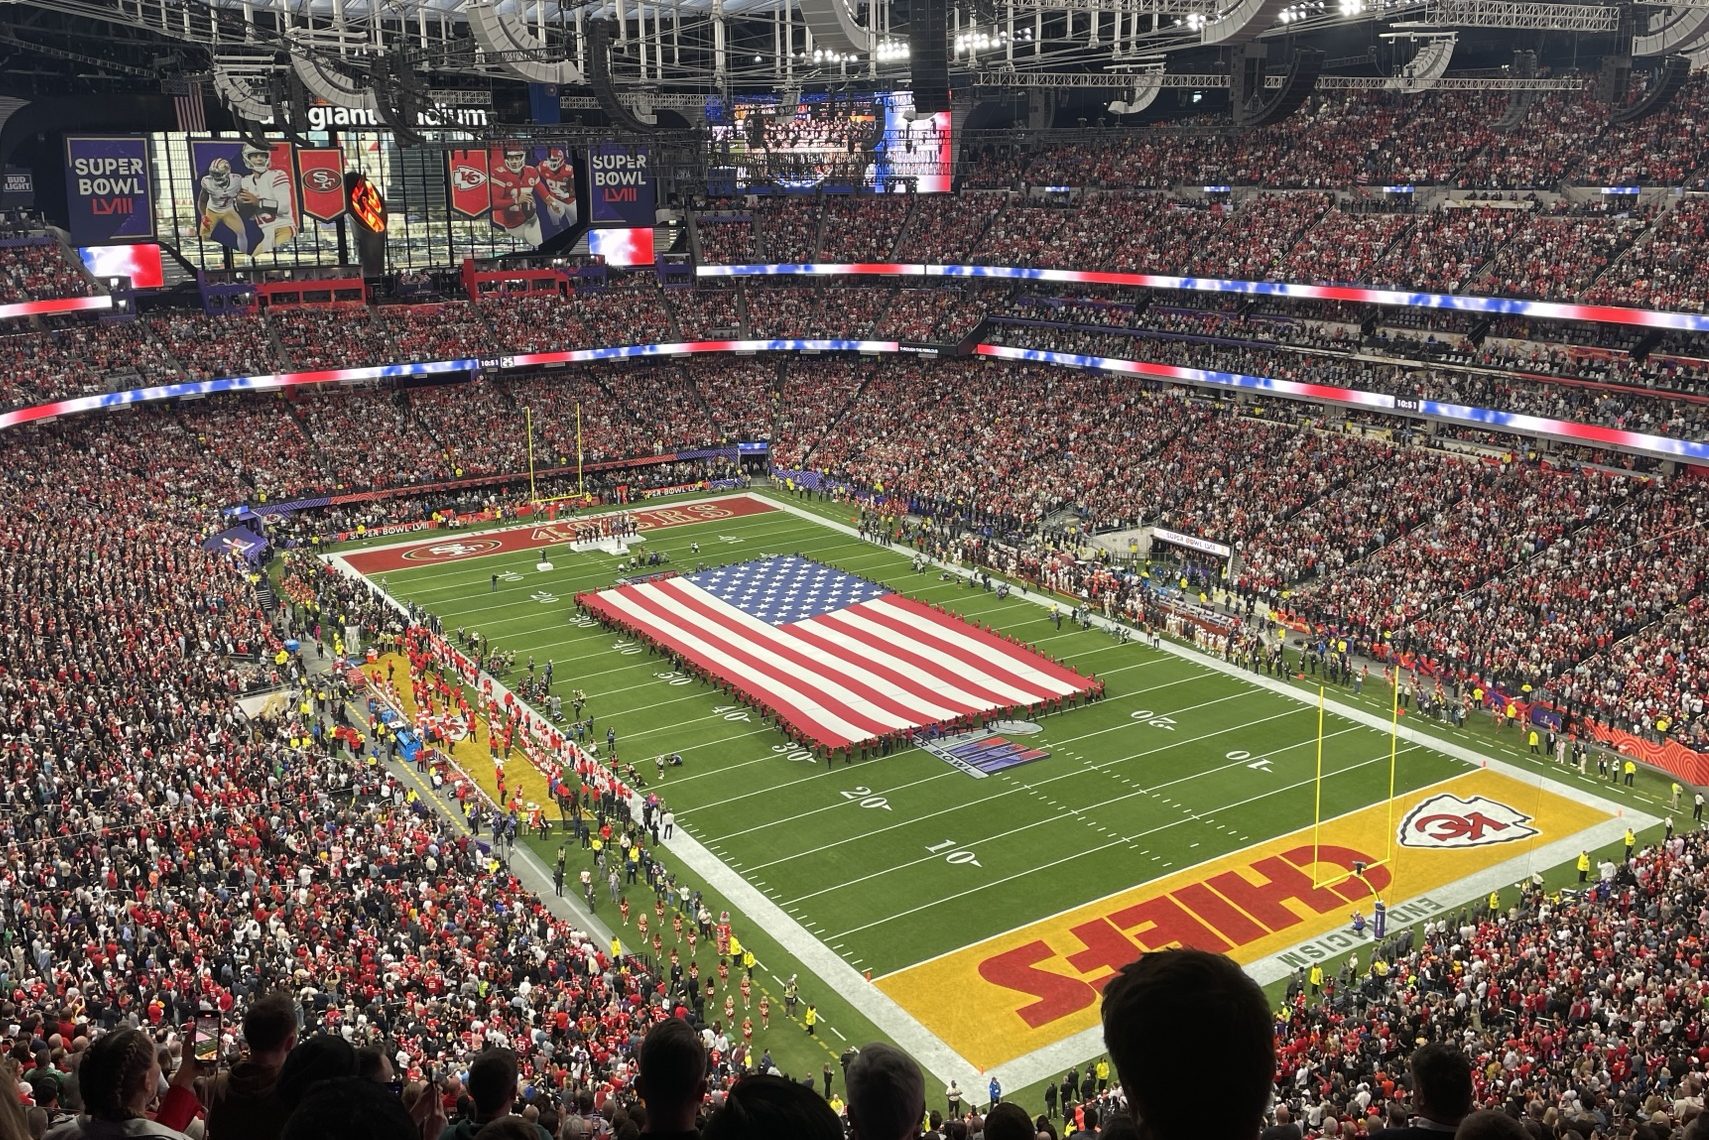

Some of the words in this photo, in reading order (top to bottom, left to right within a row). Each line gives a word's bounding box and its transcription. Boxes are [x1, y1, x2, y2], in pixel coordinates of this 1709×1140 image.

[75, 158, 143, 175] SUPER
[593, 154, 646, 169] SUPER
[4, 182, 30, 190] LIGHT
[79, 178, 144, 195] BOWL
[595, 171, 646, 186] BOWL
[603, 187, 637, 202] LVIII
[91, 197, 133, 215] LVIII
[481, 359, 499, 367] 10:51
[1397, 399, 1417, 410] 10:51
[664, 485, 687, 496] BOWL
[382, 524, 410, 536] BOWL
[412, 522, 429, 532] LVIII
[711, 705, 749, 721] 40
[1131, 709, 1177, 728] 20
[771, 741, 813, 762] 30
[1225, 750, 1275, 770] 10
[932, 749, 972, 774] BOWL
[840, 786, 888, 809] 20
[925, 839, 976, 865] 10
[1386, 897, 1445, 923] END
[978, 844, 1392, 1029] CHIEFS
